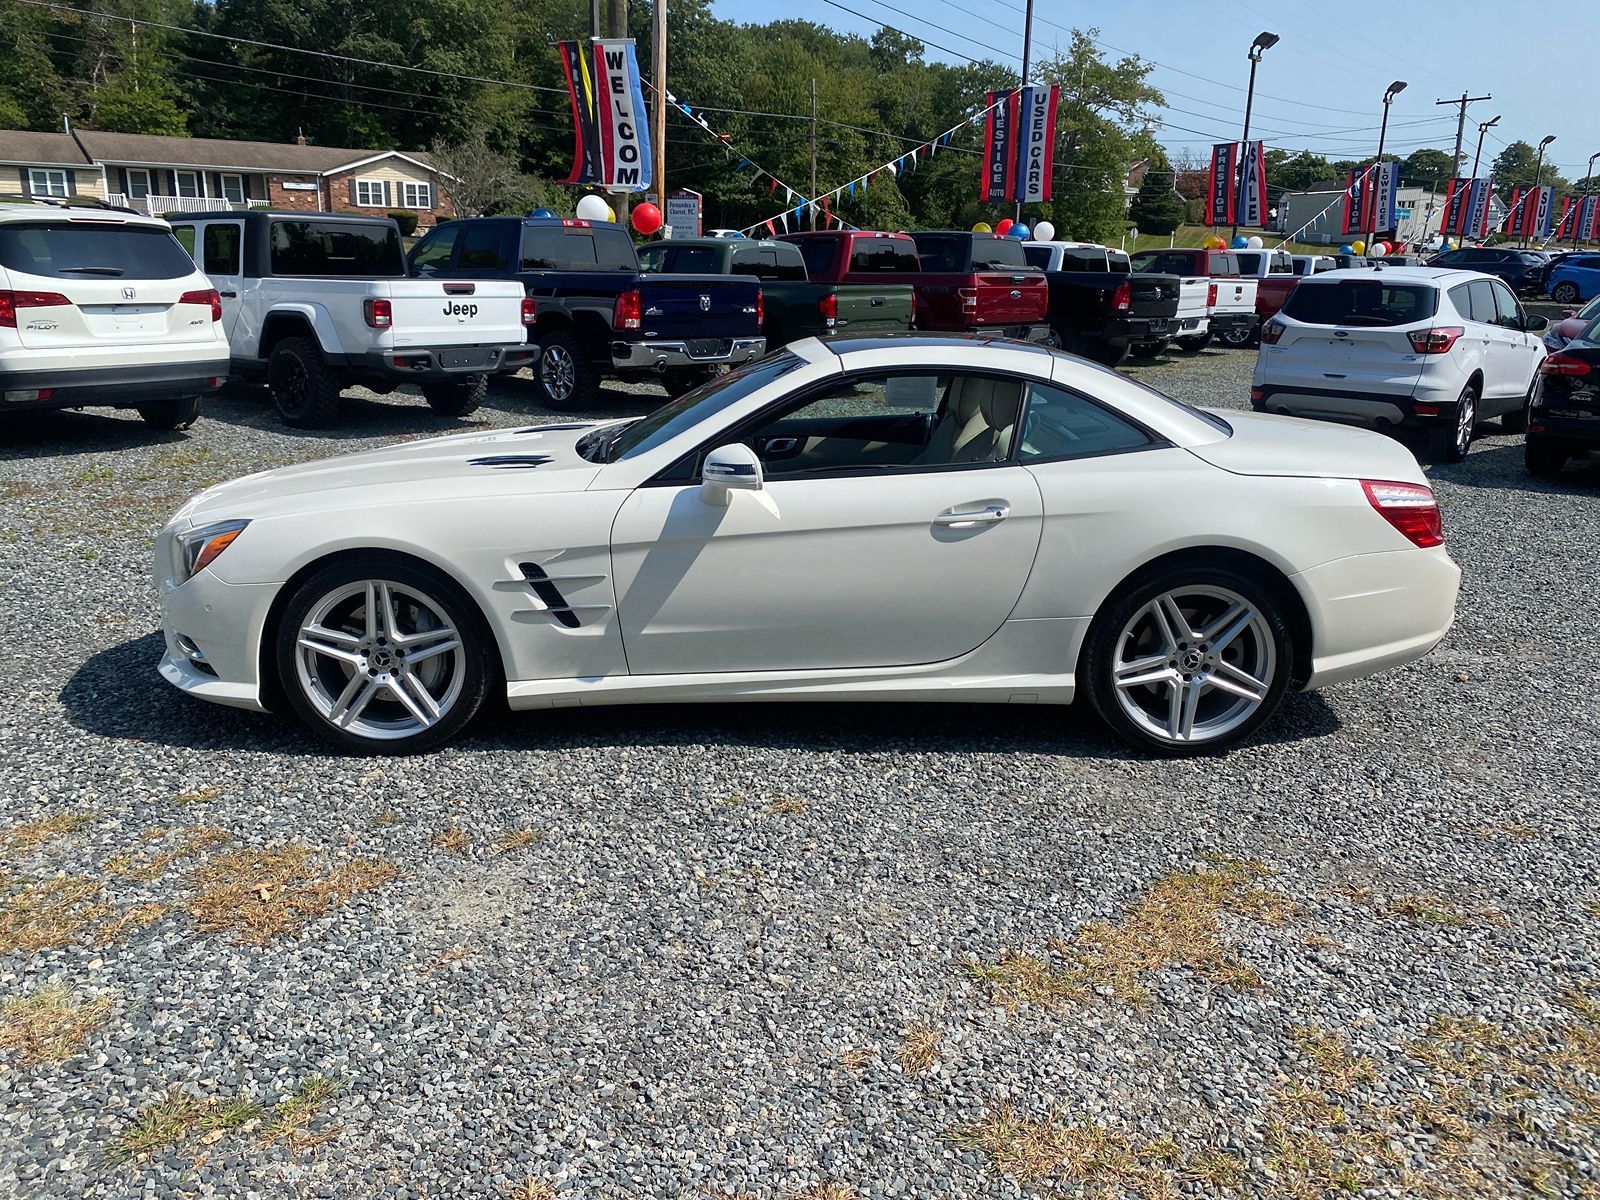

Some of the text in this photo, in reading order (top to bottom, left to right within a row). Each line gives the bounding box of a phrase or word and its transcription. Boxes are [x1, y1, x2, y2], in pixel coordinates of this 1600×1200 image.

[1029, 94, 1046, 194] USED CARS
[989, 188, 1005, 197] AUTO
[1215, 148, 1226, 213] PRESTIGE
[1248, 147, 1257, 220] SALE
[1352, 172, 1361, 222] PSTIGE
[1378, 167, 1390, 227] LOW PRICES
[1478, 182, 1489, 202] USED
[1538, 192, 1547, 231] SUV
[1587, 198, 1596, 217] USED
[442, 301, 479, 318] Jeep
